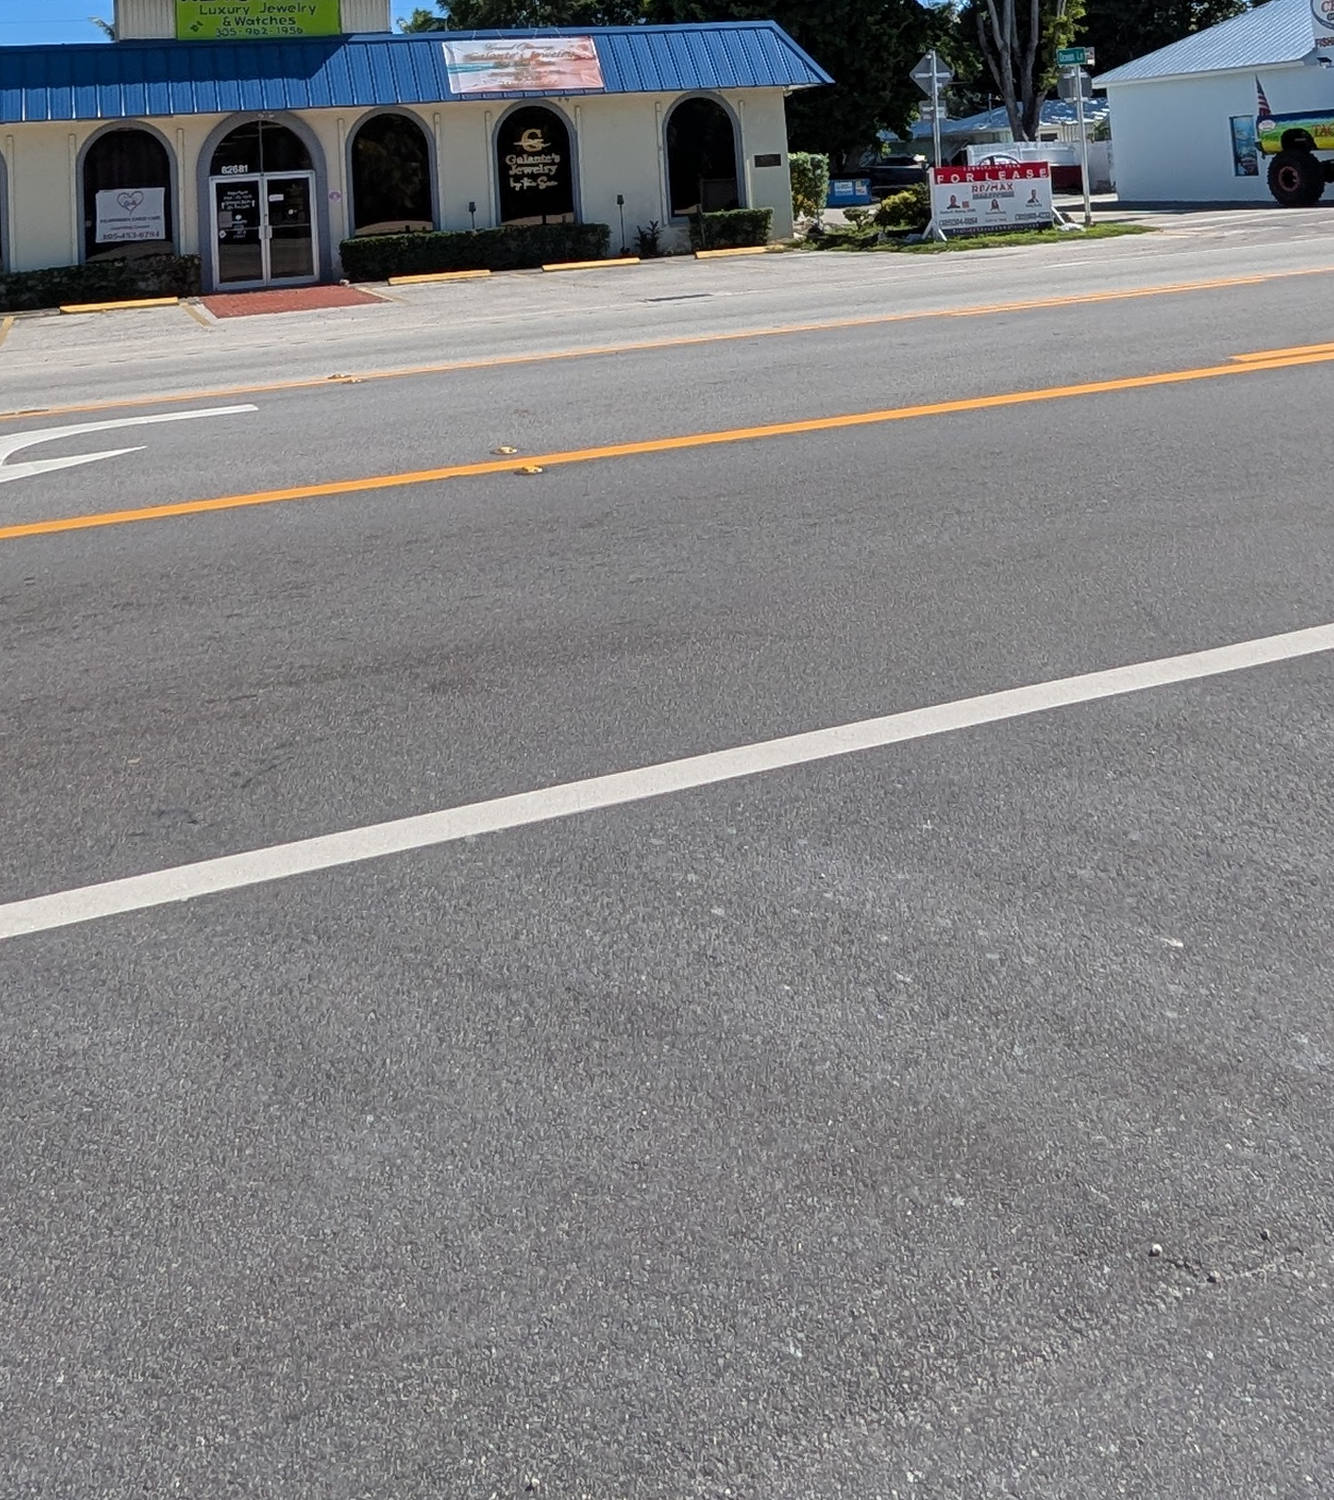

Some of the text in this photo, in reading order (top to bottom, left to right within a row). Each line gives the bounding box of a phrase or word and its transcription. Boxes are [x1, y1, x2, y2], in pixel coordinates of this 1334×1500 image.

[199, 2, 317, 16] Luxury Jewelry
[223, 16, 297, 27] & Watches
[505, 153, 561, 166] Galante's
[221, 164, 248, 174] 82681
[509, 164, 558, 176] Jewelry
[937, 168, 1048, 184] FOR LEASE
[971, 183, 1014, 194] RE/MAX
